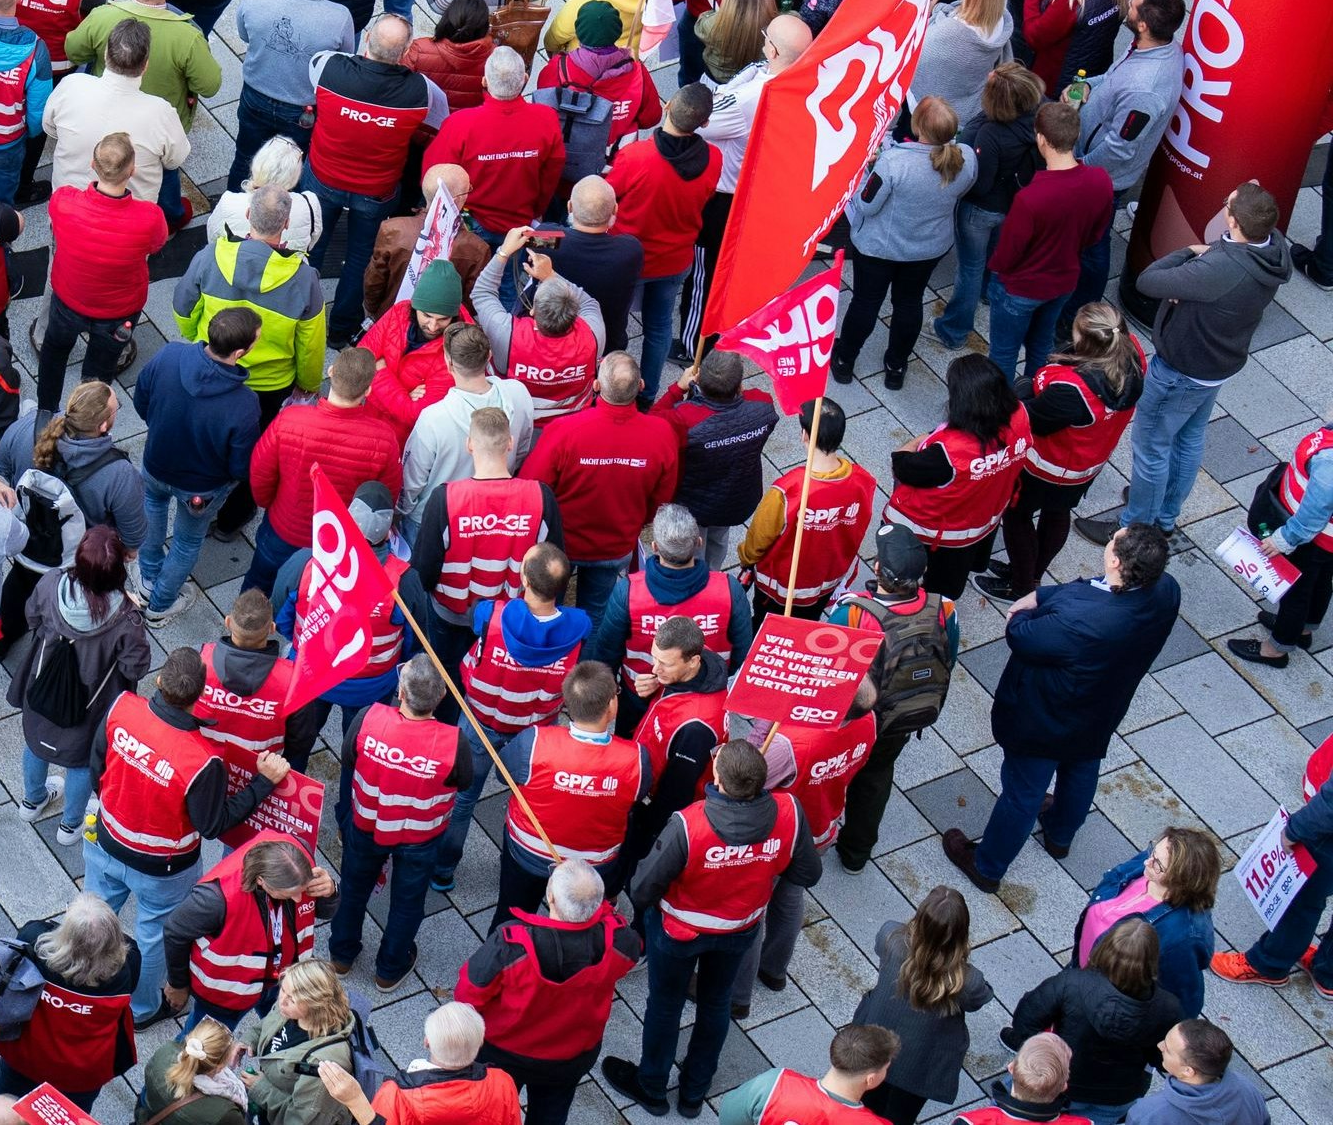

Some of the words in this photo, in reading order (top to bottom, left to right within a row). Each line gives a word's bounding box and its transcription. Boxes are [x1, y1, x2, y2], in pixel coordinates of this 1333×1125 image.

[1088, 5, 1119, 26] GEWERKS
[340, 107, 397, 128] PRO-GE
[478, 154, 495, 162] MACHT
[509, 151, 524, 159] STARK
[515, 362, 588, 383] PRO-GE
[704, 425, 769, 450] GEWERKSCHAFT
[580, 458, 597, 466] MACHT
[613, 457, 630, 465] STARK
[970, 445, 1010, 475] GPA
[458, 513, 533, 532] PRO-GE
[765, 634, 794, 648] WIR
[753, 654, 783, 669] FÜR
[786, 660, 858, 680] UNSEREN
[757, 643, 834, 667] KÄMPFEN
[745, 675, 818, 697] VERTRAG!
[749, 664, 836, 689] KOLLEKTIV-
[203, 684, 279, 716] PRO-GE
[790, 703, 838, 725] gpa
[113, 726, 155, 765] GPA
[155, 758, 175, 781] djp
[364, 736, 441, 774] PRO-GE
[554, 771, 598, 790] GPA
[601, 776, 618, 791] djp
[705, 844, 754, 863] GPA
[761, 838, 781, 856] djp
[1245, 843, 1287, 899] 11,6%
[41, 990, 94, 1015] RO-GE
